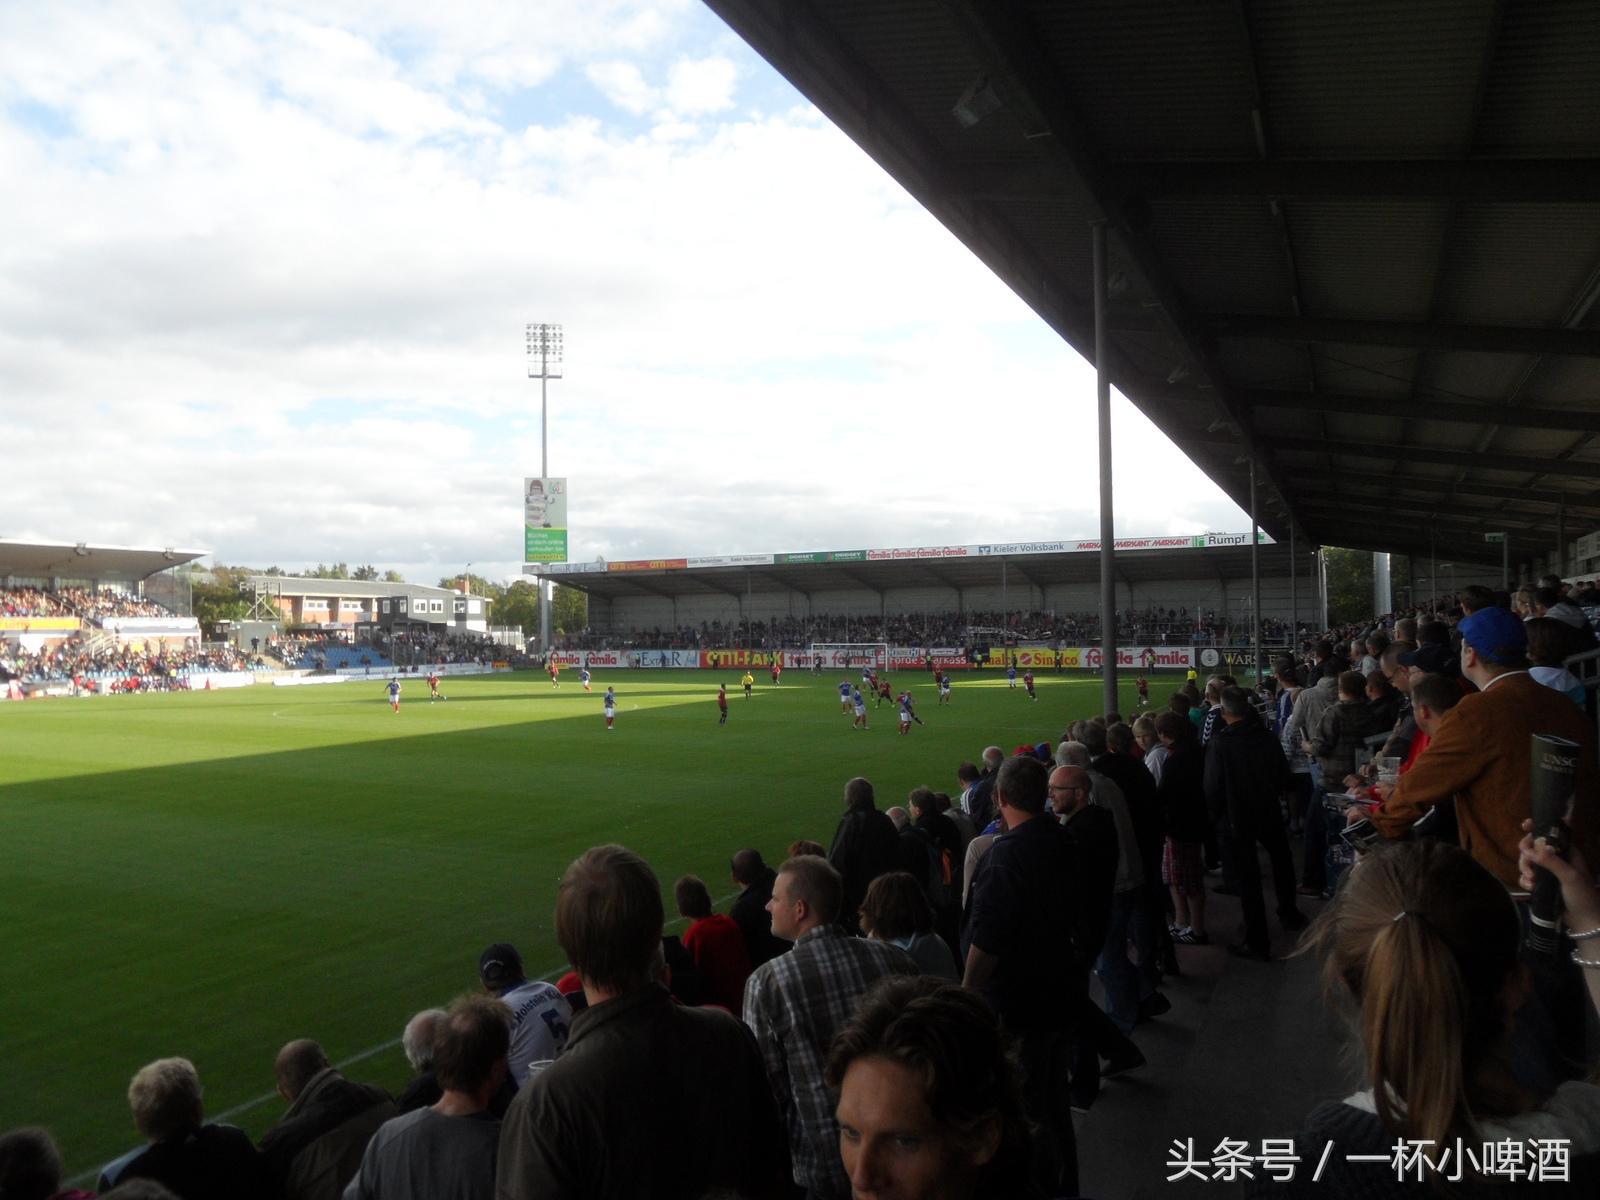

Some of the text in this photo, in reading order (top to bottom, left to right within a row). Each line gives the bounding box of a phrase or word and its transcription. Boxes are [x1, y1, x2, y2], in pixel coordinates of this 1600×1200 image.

[1152, 538, 1191, 547] MARKANT
[1208, 534, 1247, 546] Rumpf
[891, 549, 916, 559] famila
[916, 547, 941, 557] famila
[942, 546, 967, 556] famila
[993, 543, 1065, 553] Kieler Volksbank
